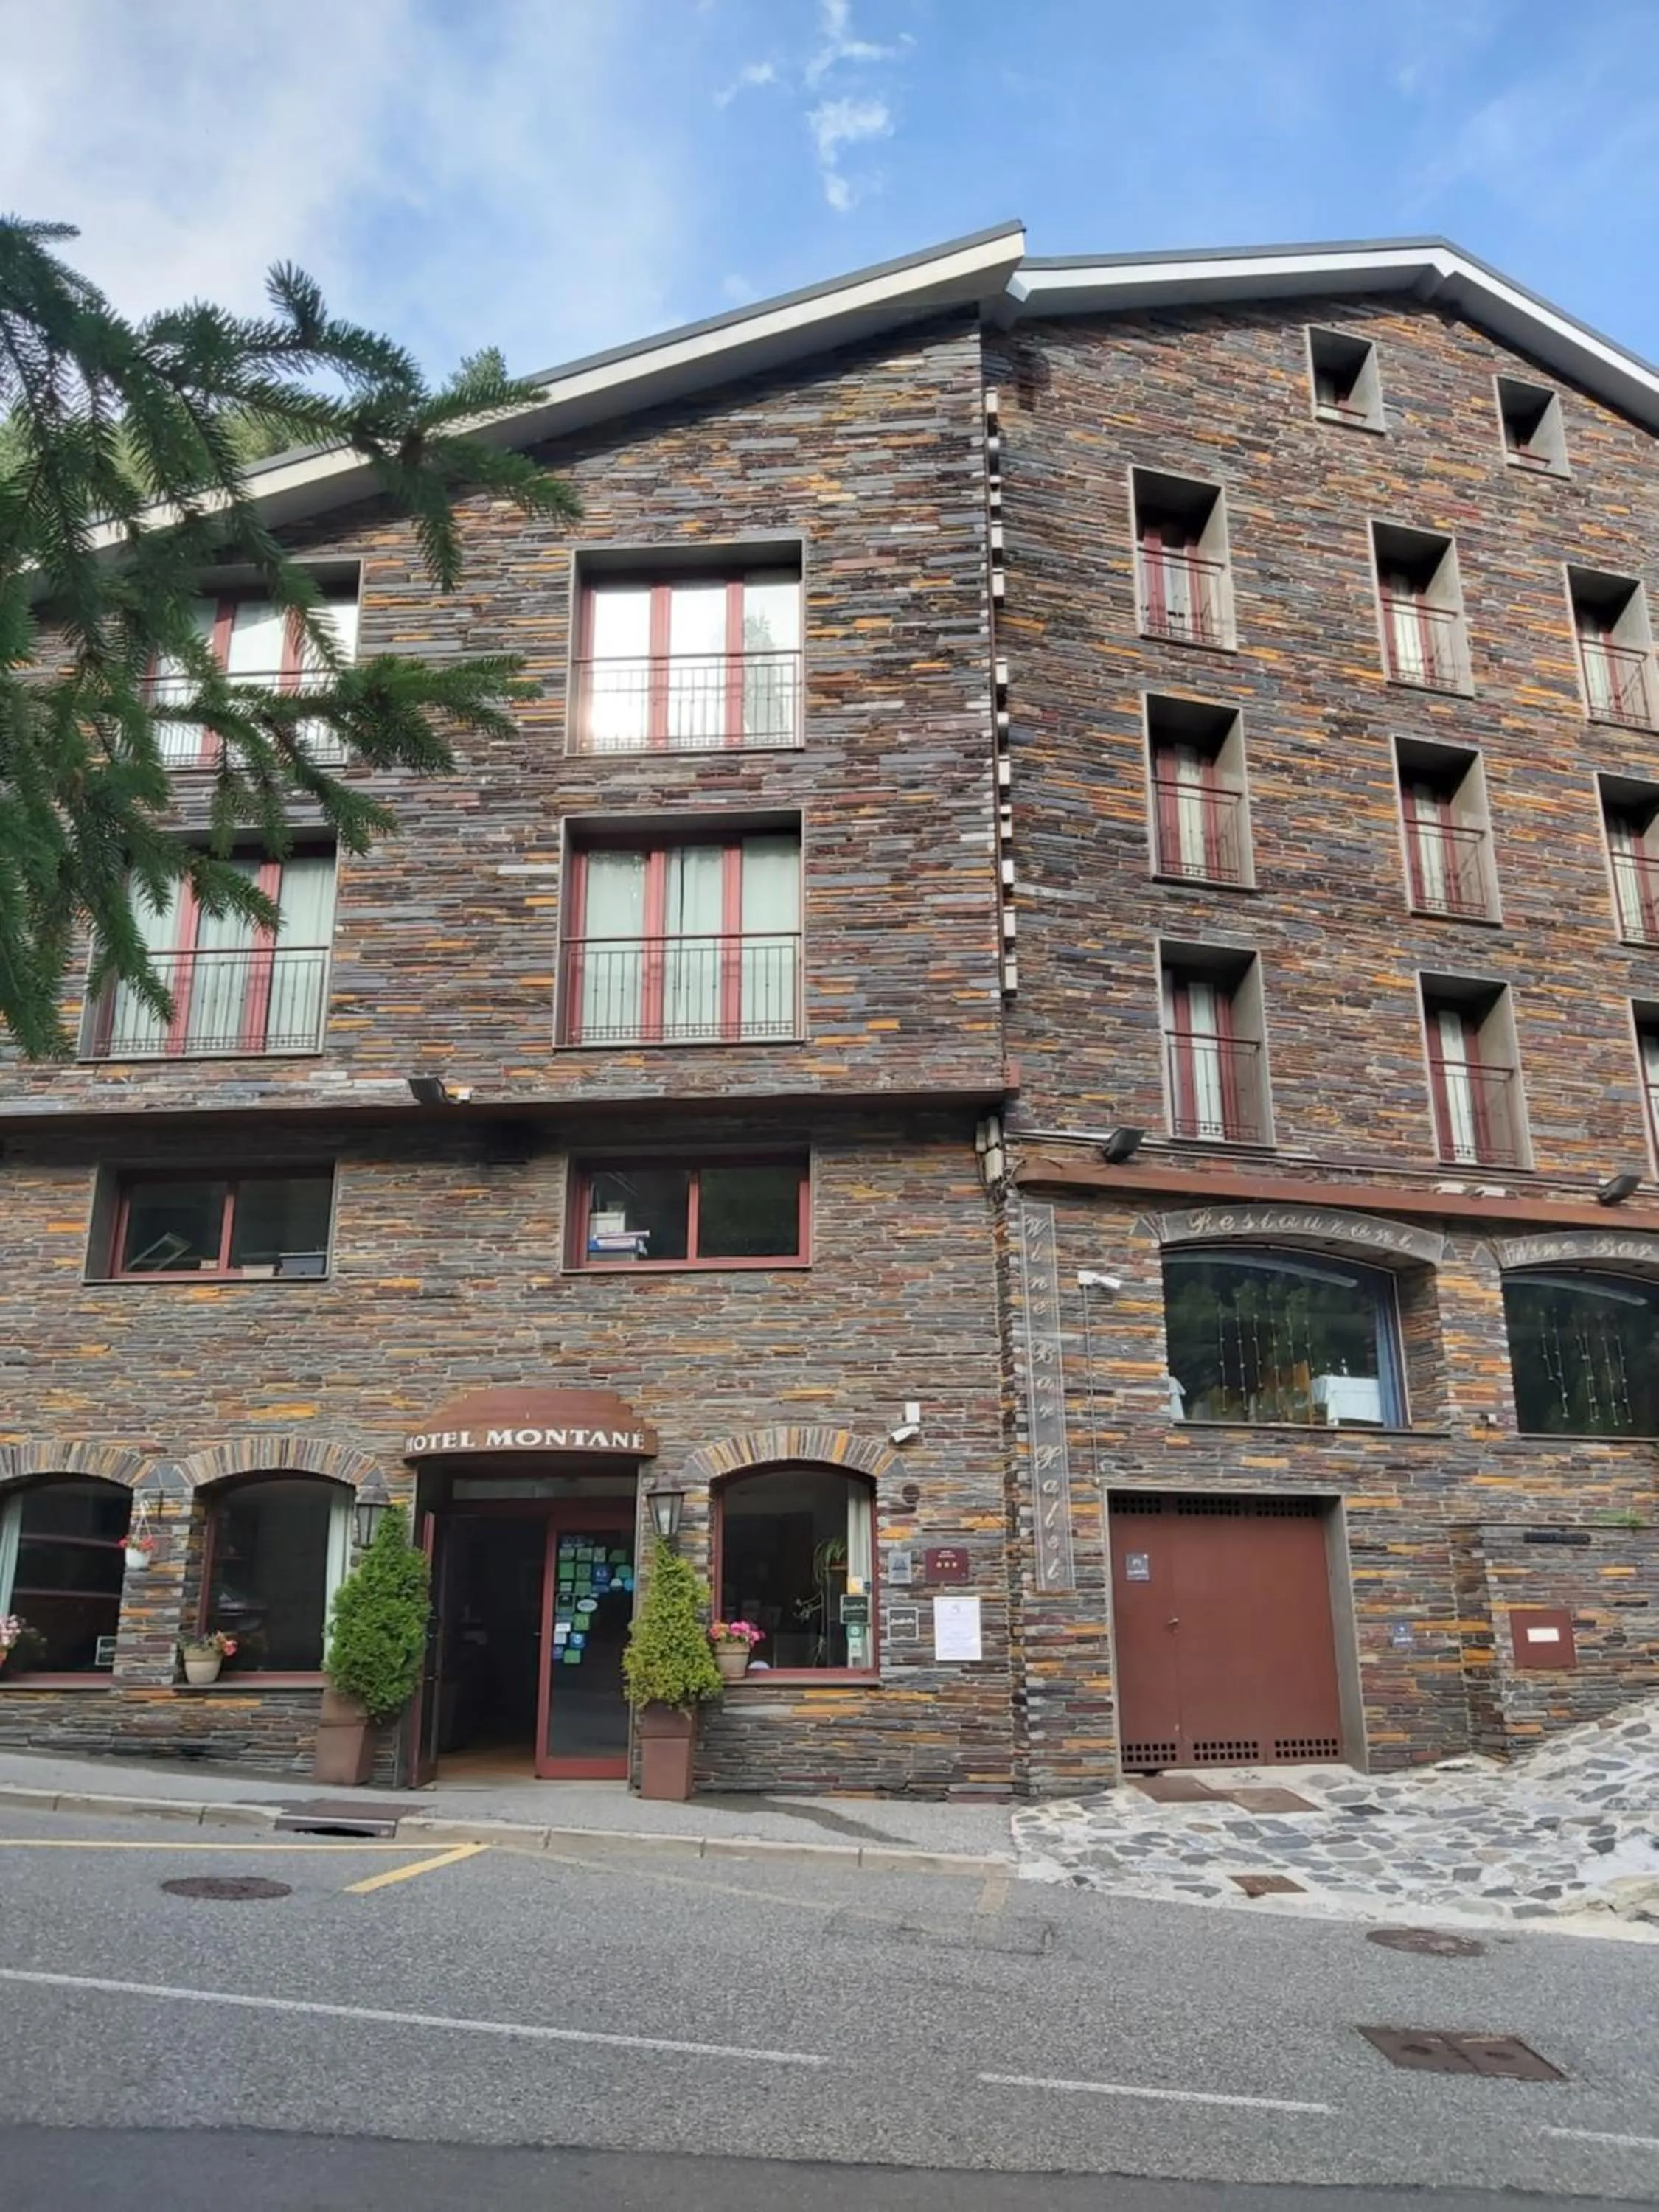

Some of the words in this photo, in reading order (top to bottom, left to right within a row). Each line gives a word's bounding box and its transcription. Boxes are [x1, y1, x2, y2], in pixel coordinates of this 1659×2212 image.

[1188, 1207, 1414, 1248] Restaurant
[406, 1430, 476, 1452] HOTEL
[486, 1428, 645, 1450] MONTANÉ
